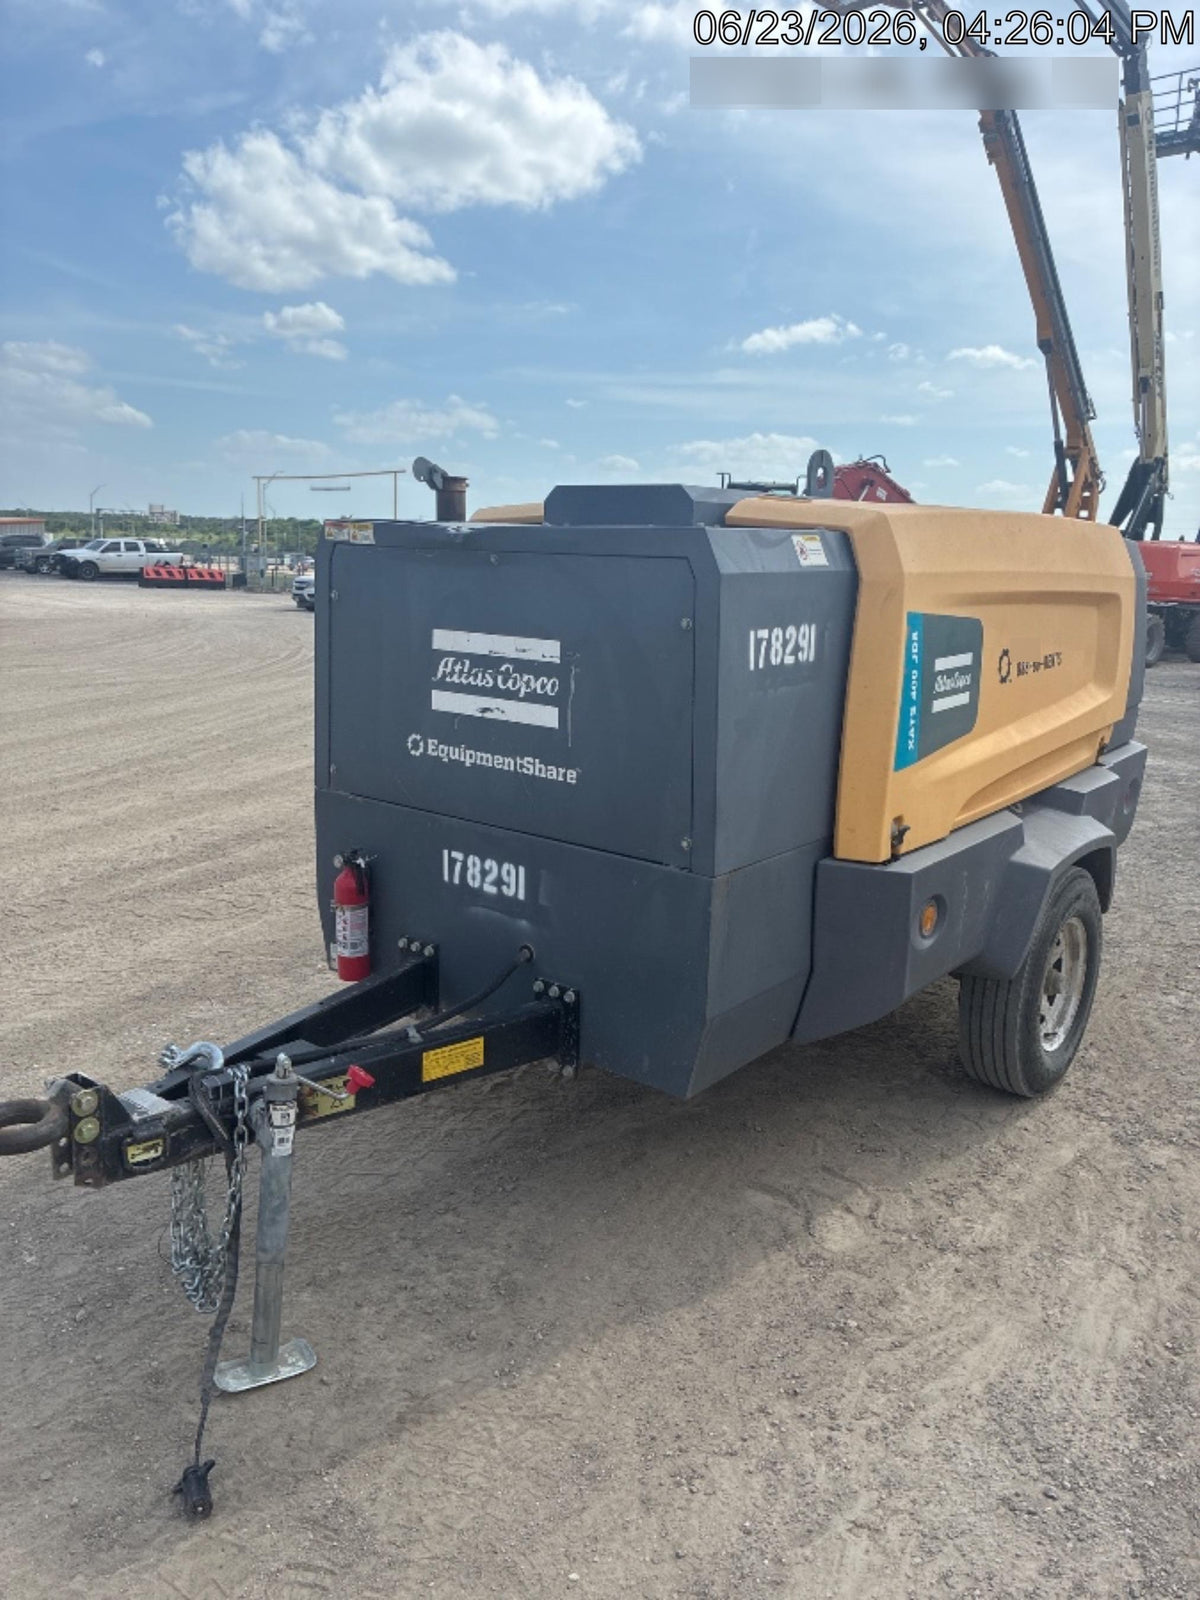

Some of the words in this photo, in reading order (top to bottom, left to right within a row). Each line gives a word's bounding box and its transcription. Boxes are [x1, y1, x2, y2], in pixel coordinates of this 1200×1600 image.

[749, 623, 817, 671] 178291
[432, 656, 495, 688] Atlas
[496, 663, 559, 698] Copco
[909, 669, 919, 701] 400
[427, 738, 578, 784] EquipmentShare
[442, 849, 526, 901] 178291
